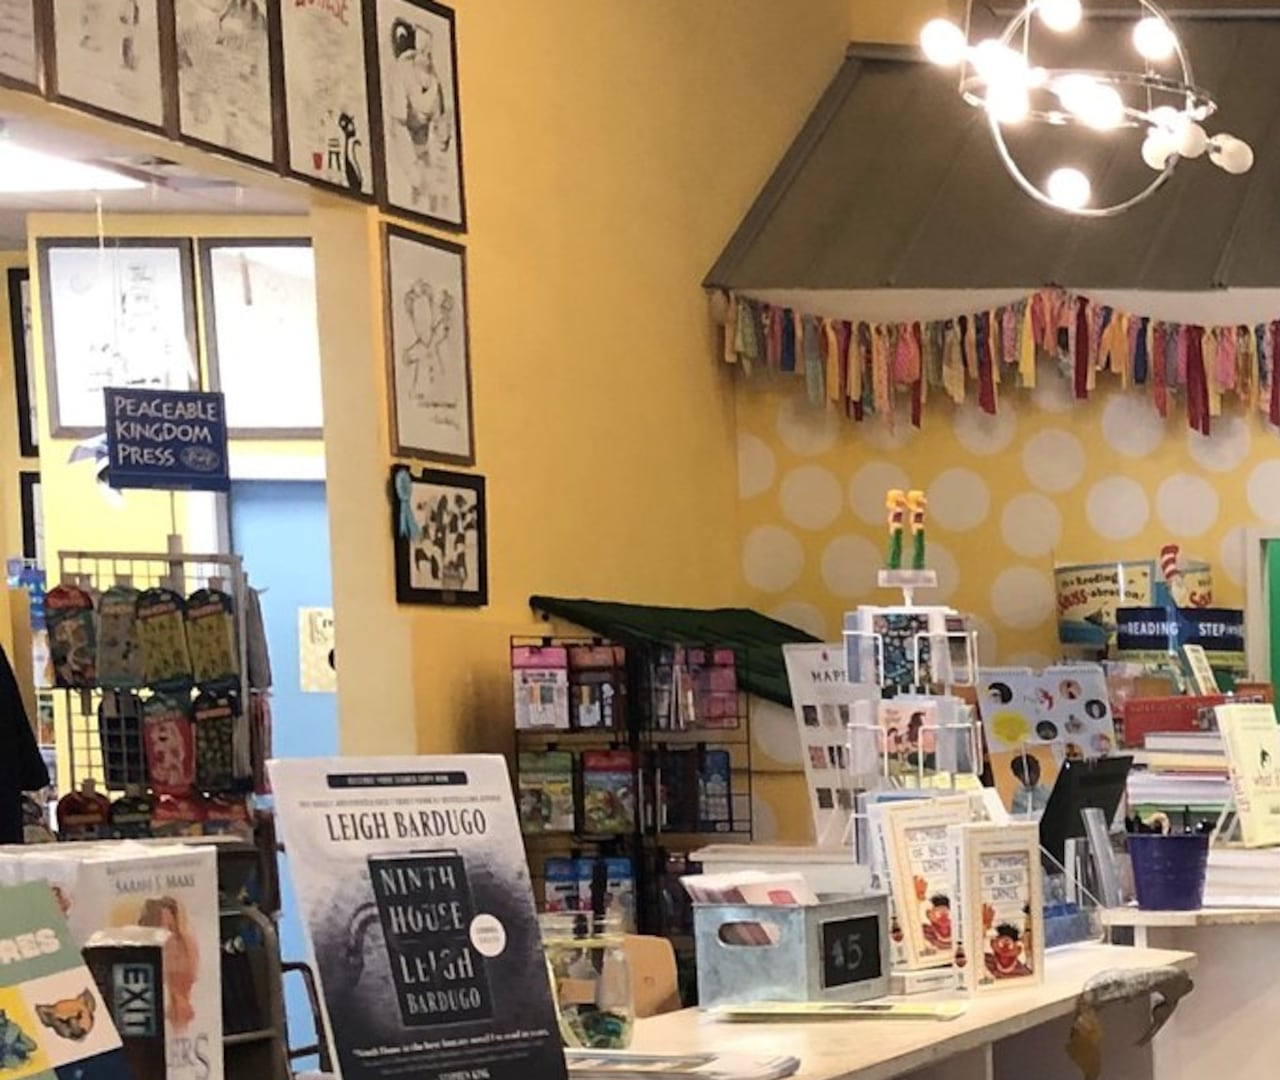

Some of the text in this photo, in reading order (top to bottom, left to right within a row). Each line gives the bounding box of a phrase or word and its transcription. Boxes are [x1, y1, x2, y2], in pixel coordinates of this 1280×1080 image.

[114, 395, 217, 421] PEACEABLE
[115, 420, 213, 443] KINGDOM
[117, 443, 176, 467] PRESS
[1128, 620, 1180, 636] READING
[1200, 622, 1226, 637] STEP
[326, 808, 487, 842] LEIGH BARDUGO
[379, 865, 456, 896] NINTH
[388, 901, 466, 934] HOUSE
[399, 948, 476, 985] LEIGH
[119, 967, 151, 1032] EXIT
[406, 986, 482, 1015] BARDUGO
